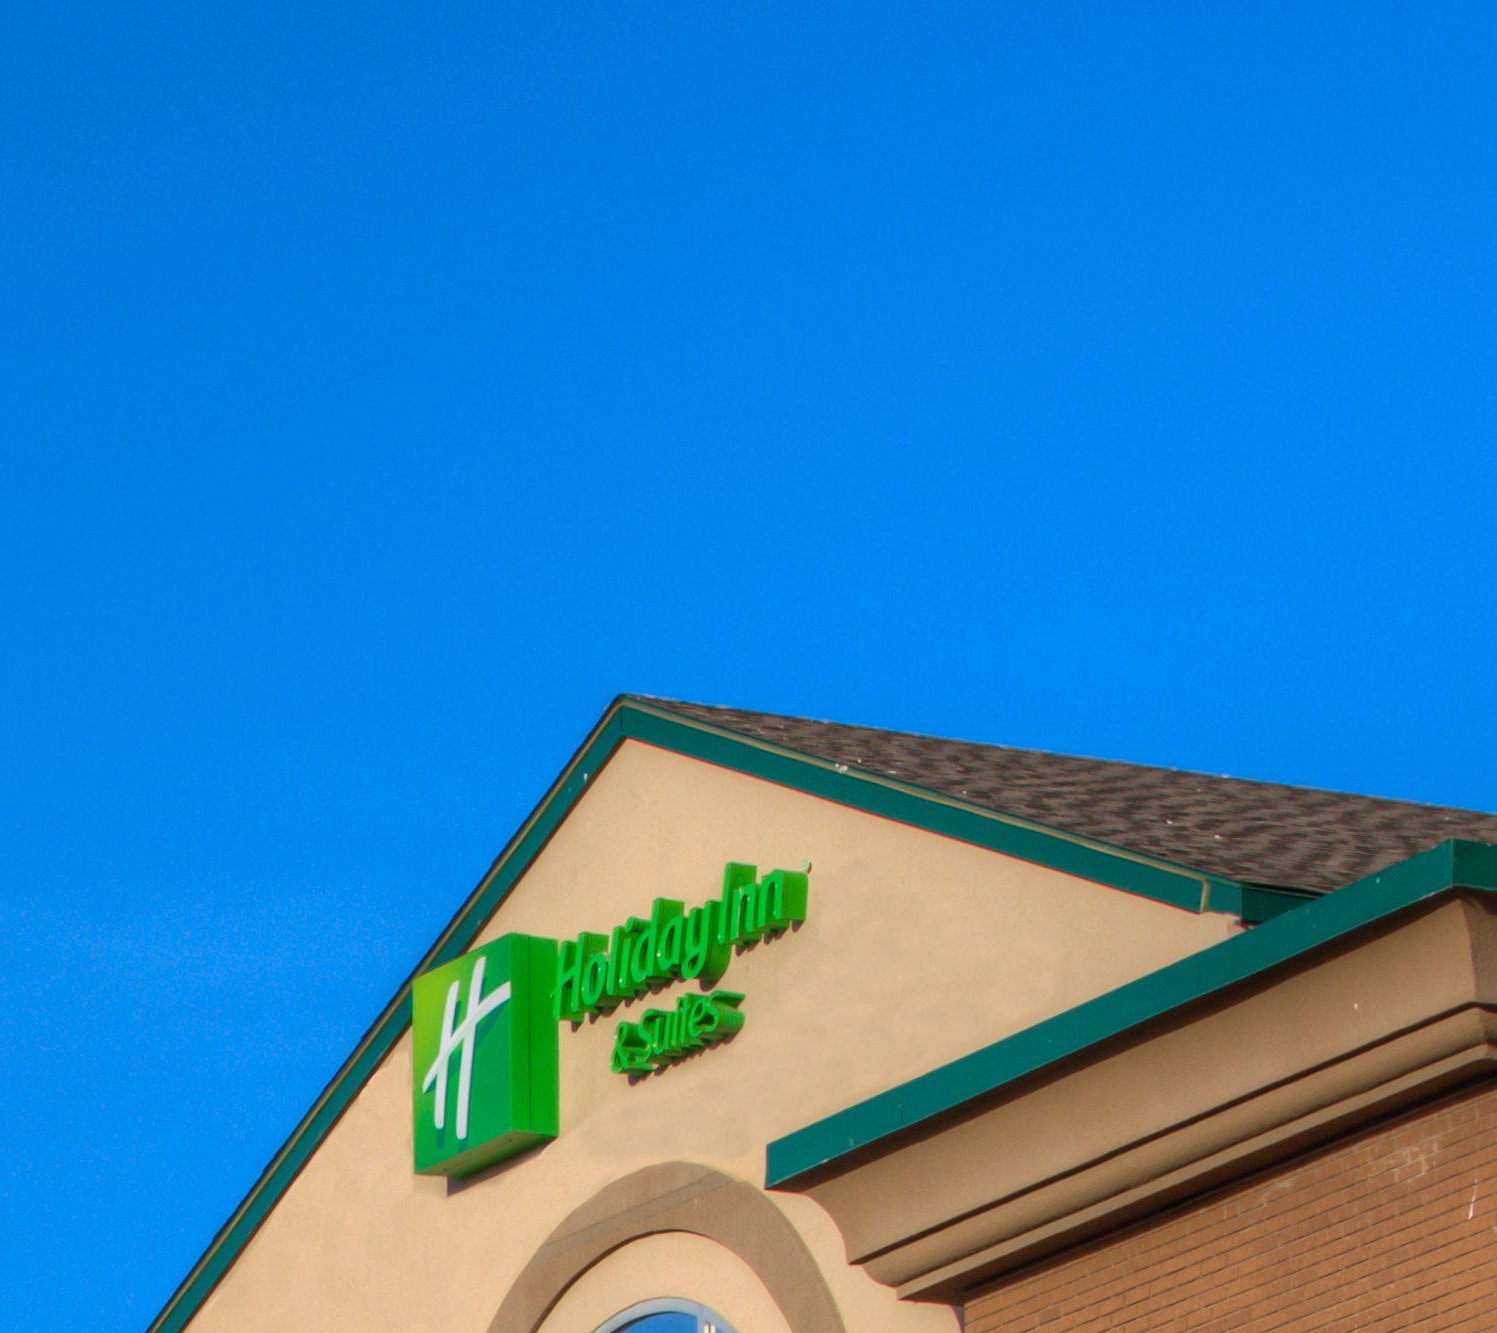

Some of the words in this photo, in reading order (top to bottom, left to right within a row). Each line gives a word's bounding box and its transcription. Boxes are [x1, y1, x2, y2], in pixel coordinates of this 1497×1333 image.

[550, 898, 729, 1021] Holiday
[717, 861, 808, 945] Inn
[636, 990, 743, 1066] Suites
